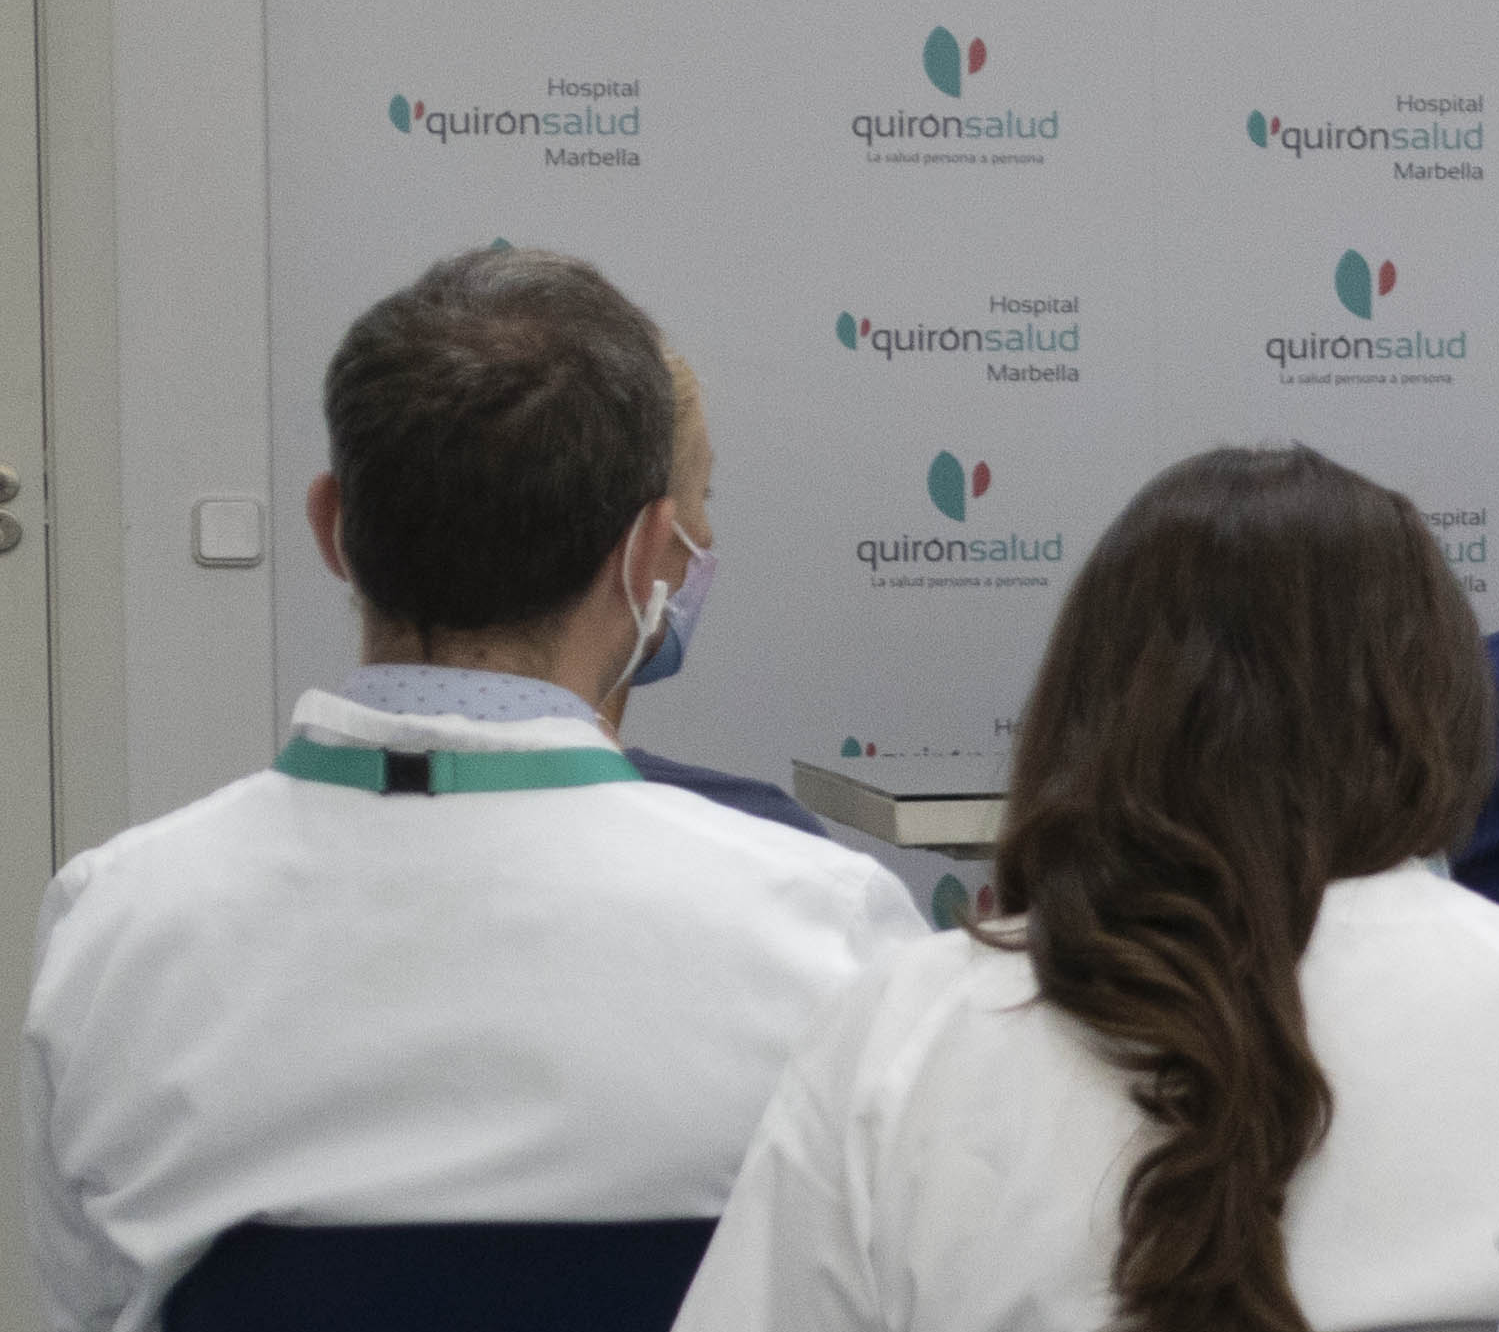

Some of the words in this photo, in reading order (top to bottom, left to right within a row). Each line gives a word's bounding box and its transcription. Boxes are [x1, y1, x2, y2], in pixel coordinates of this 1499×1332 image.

[547, 78, 640, 100] Hospital
[1396, 94, 1484, 115] Hospital
[545, 147, 640, 167] Marbella
[1393, 160, 1484, 180] Marbella
[990, 295, 1079, 317] Hospital
[986, 363, 1079, 383] Marbella
[1422, 507, 1487, 529] spital
